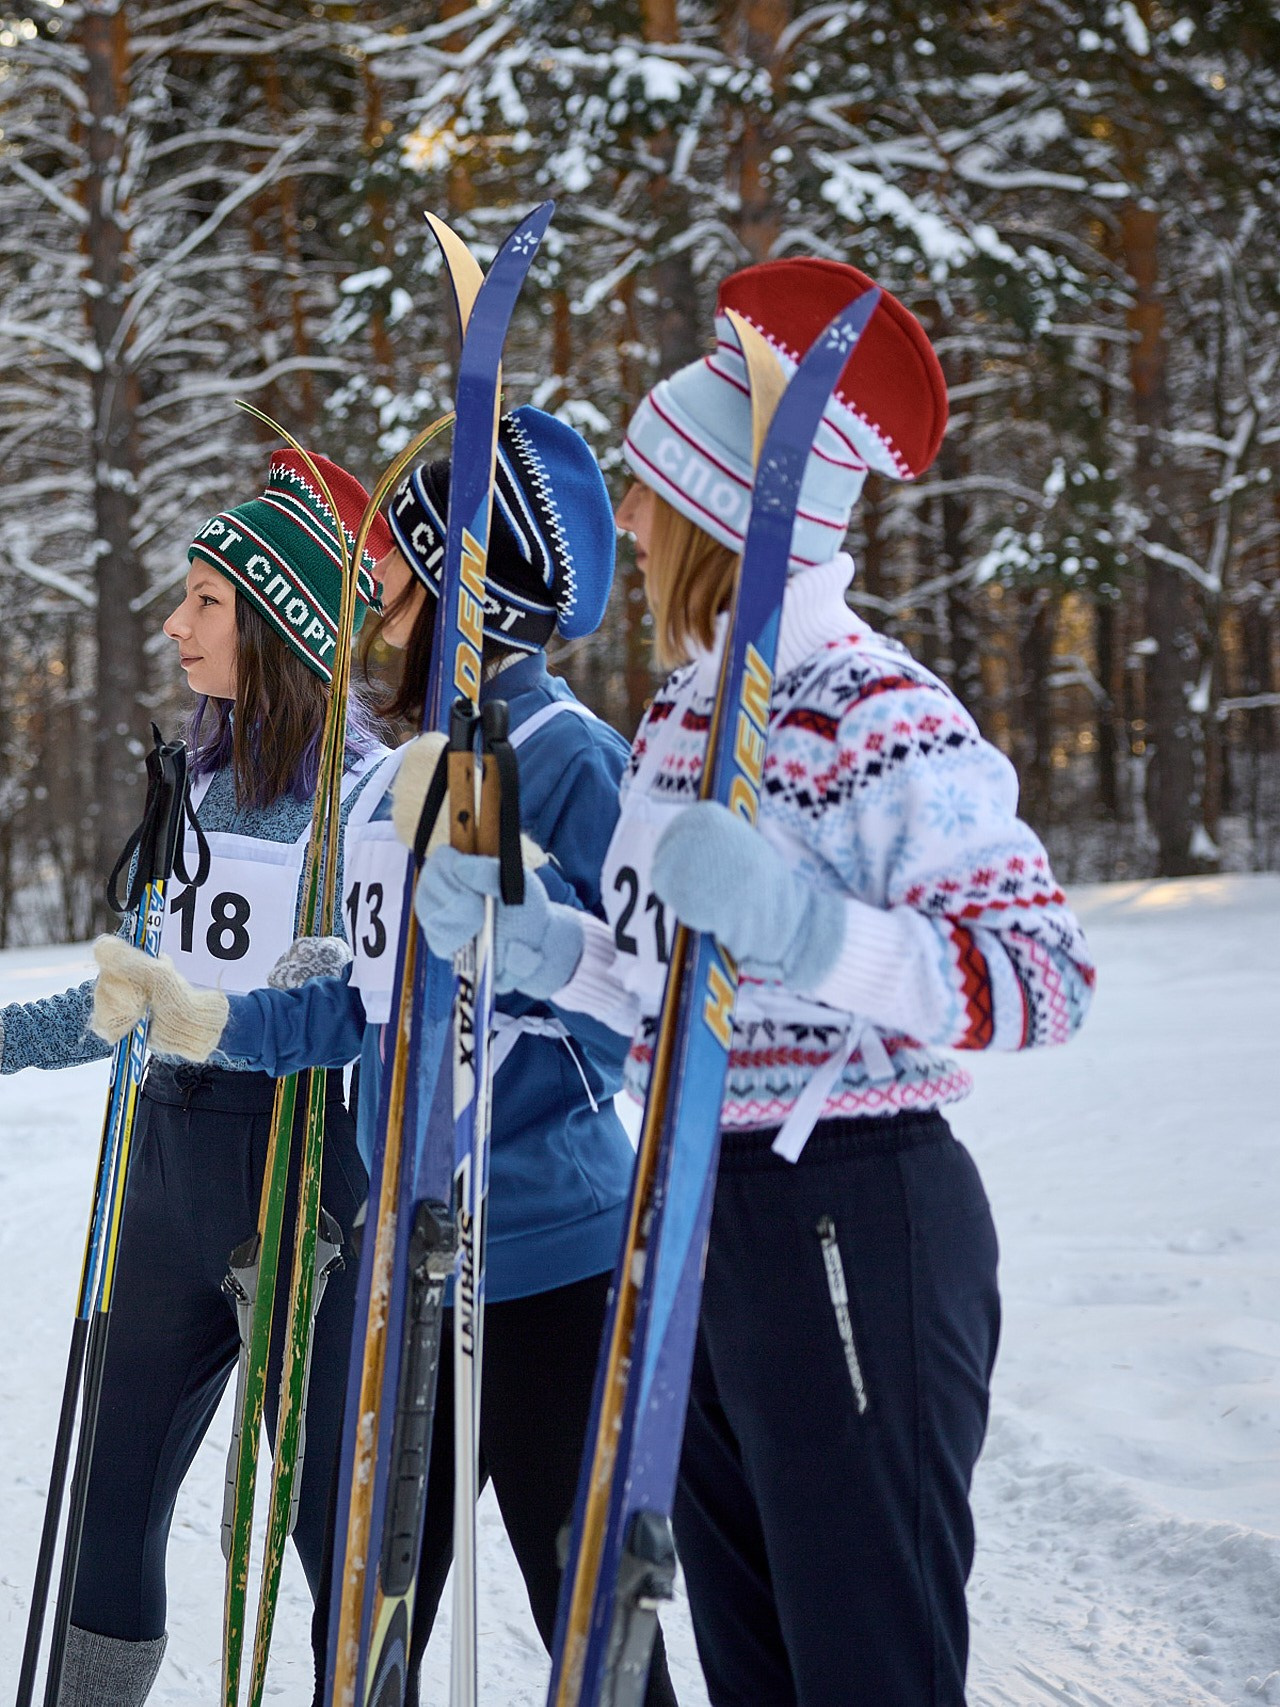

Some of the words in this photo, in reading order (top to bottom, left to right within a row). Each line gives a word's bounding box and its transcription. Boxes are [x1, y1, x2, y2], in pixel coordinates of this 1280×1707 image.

[655, 436, 744, 520] СПО
[245, 553, 336, 656] СПОРТ
[454, 526, 487, 706] DEN
[169, 884, 251, 961] 18
[346, 882, 387, 958] 13
[614, 865, 669, 963] 21
[461, 1211, 474, 1358] SPRINT
